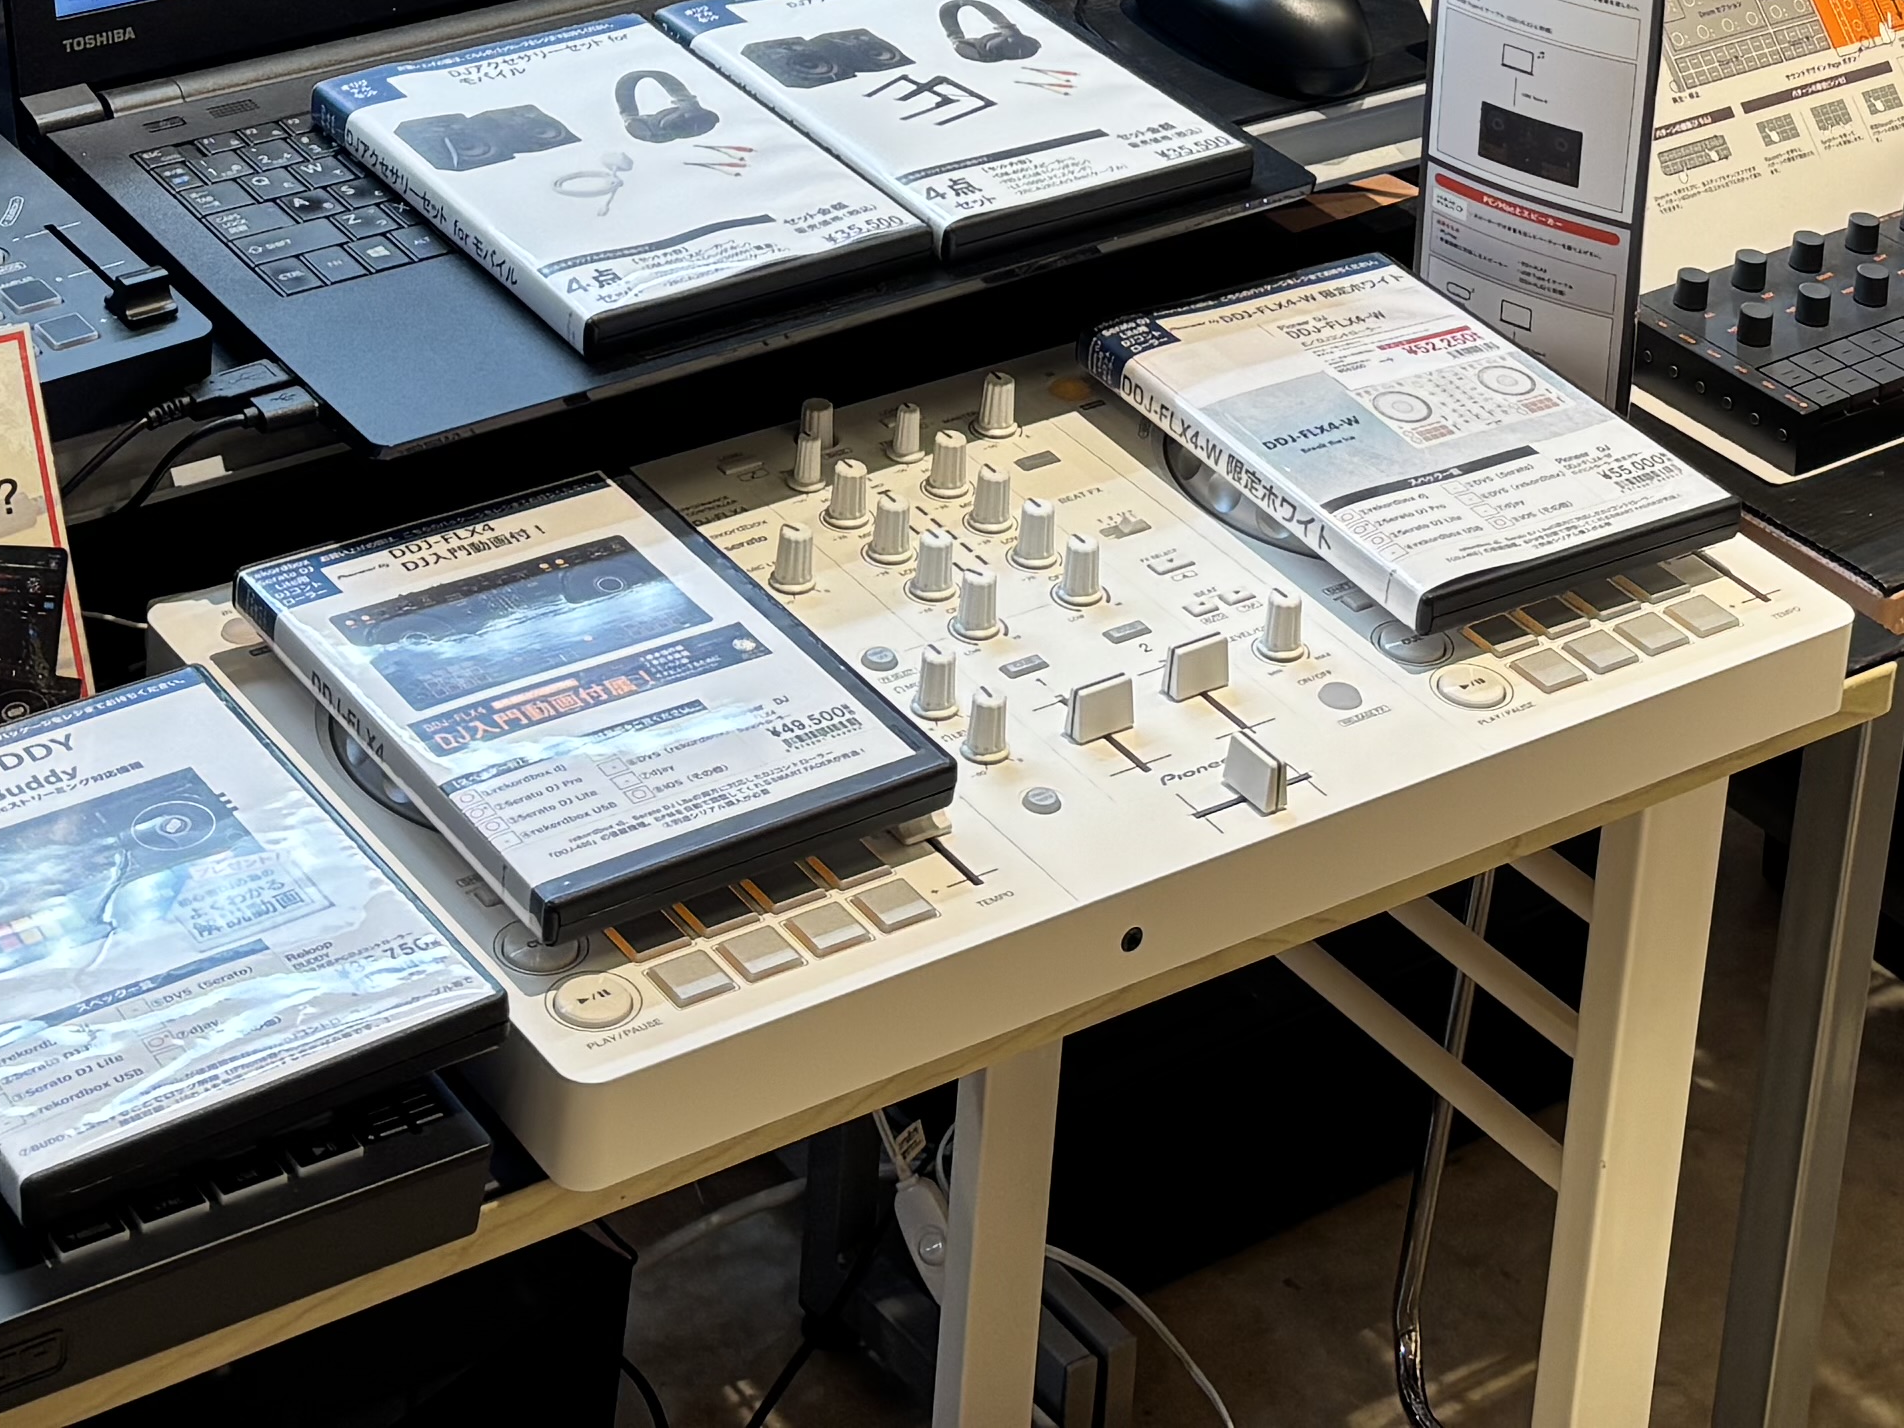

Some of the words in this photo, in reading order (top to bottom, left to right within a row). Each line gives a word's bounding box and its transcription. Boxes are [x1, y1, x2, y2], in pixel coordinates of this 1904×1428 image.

[63, 28, 135, 53] TOSHIBA
[1155, 135, 1230, 162] ¥35,500
[823, 215, 904, 246] ¥35,500
[1263, 414, 1360, 451] DDJ-FLX4-W
[1120, 373, 1225, 465] DDJ-FLX4-W
[1227, 460, 1333, 553] 限定ホワイト
[388, 521, 496, 561] DDJ-FLX4
[768, 705, 845, 738] ¥49,500
